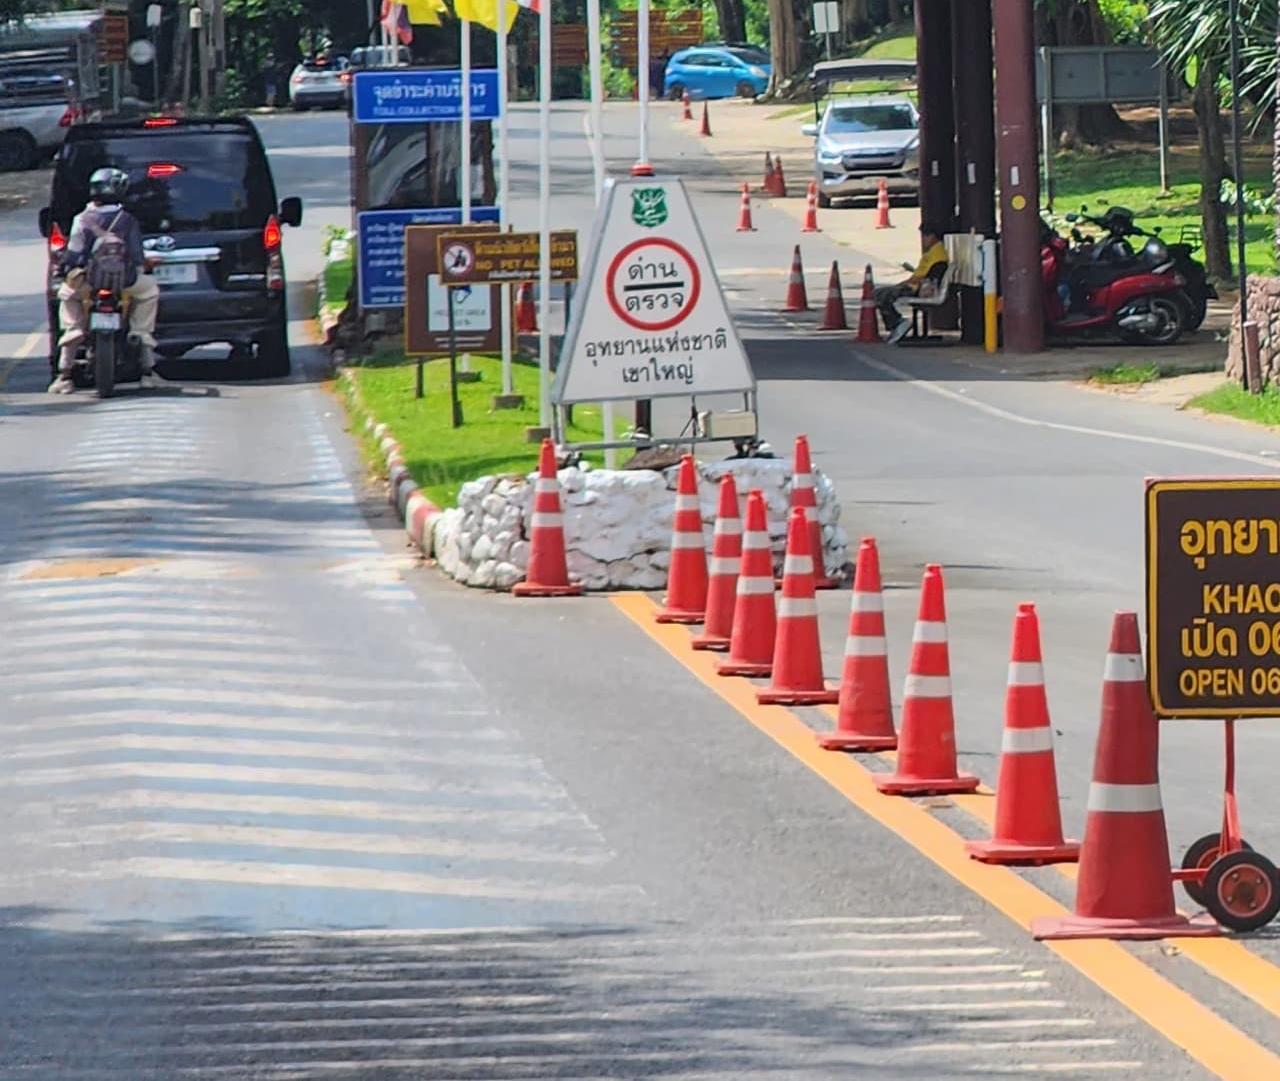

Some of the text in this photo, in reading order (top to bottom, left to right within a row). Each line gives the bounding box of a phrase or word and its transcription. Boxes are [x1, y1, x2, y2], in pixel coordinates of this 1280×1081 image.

[372, 78, 486, 105] จุดชำระค่าบริาร
[500, 259, 522, 270] PET
[628, 256, 679, 280] ด่าน
[625, 292, 684, 311] ตรวจ
[585, 327, 727, 367] อุทยานแห่งชาติ
[622, 357, 694, 385] เขาใหญ่
[1181, 617, 1238, 658] เปิด
[1179, 668, 1244, 697] OPEN
